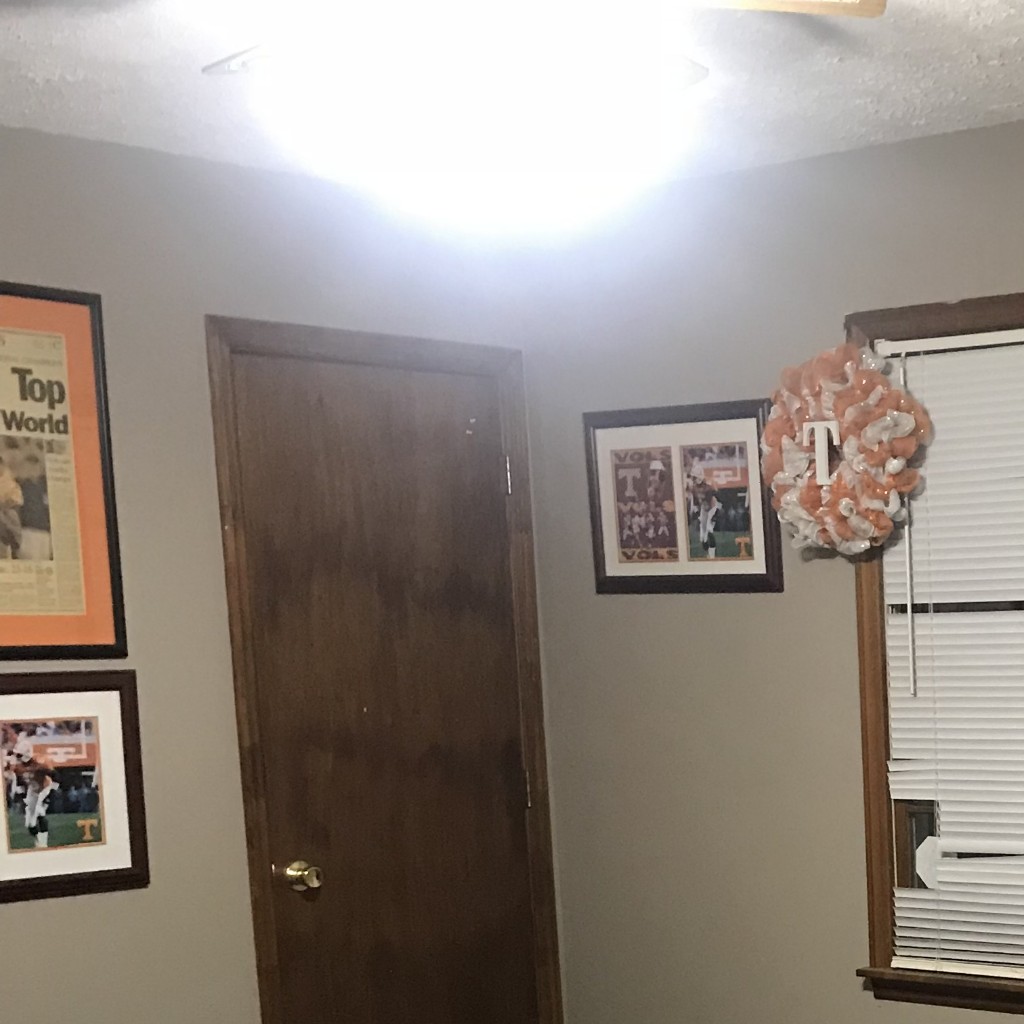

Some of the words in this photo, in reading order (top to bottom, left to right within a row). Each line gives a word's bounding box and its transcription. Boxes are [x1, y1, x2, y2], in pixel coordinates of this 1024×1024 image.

[10, 366, 66, 410] Top
[0, 409, 69, 434] World
[803, 420, 841, 486] T
[617, 468, 641, 498] T
[621, 549, 679, 560] VOLS
[735, 537, 751, 558] T
[76, 818, 98, 841] T
